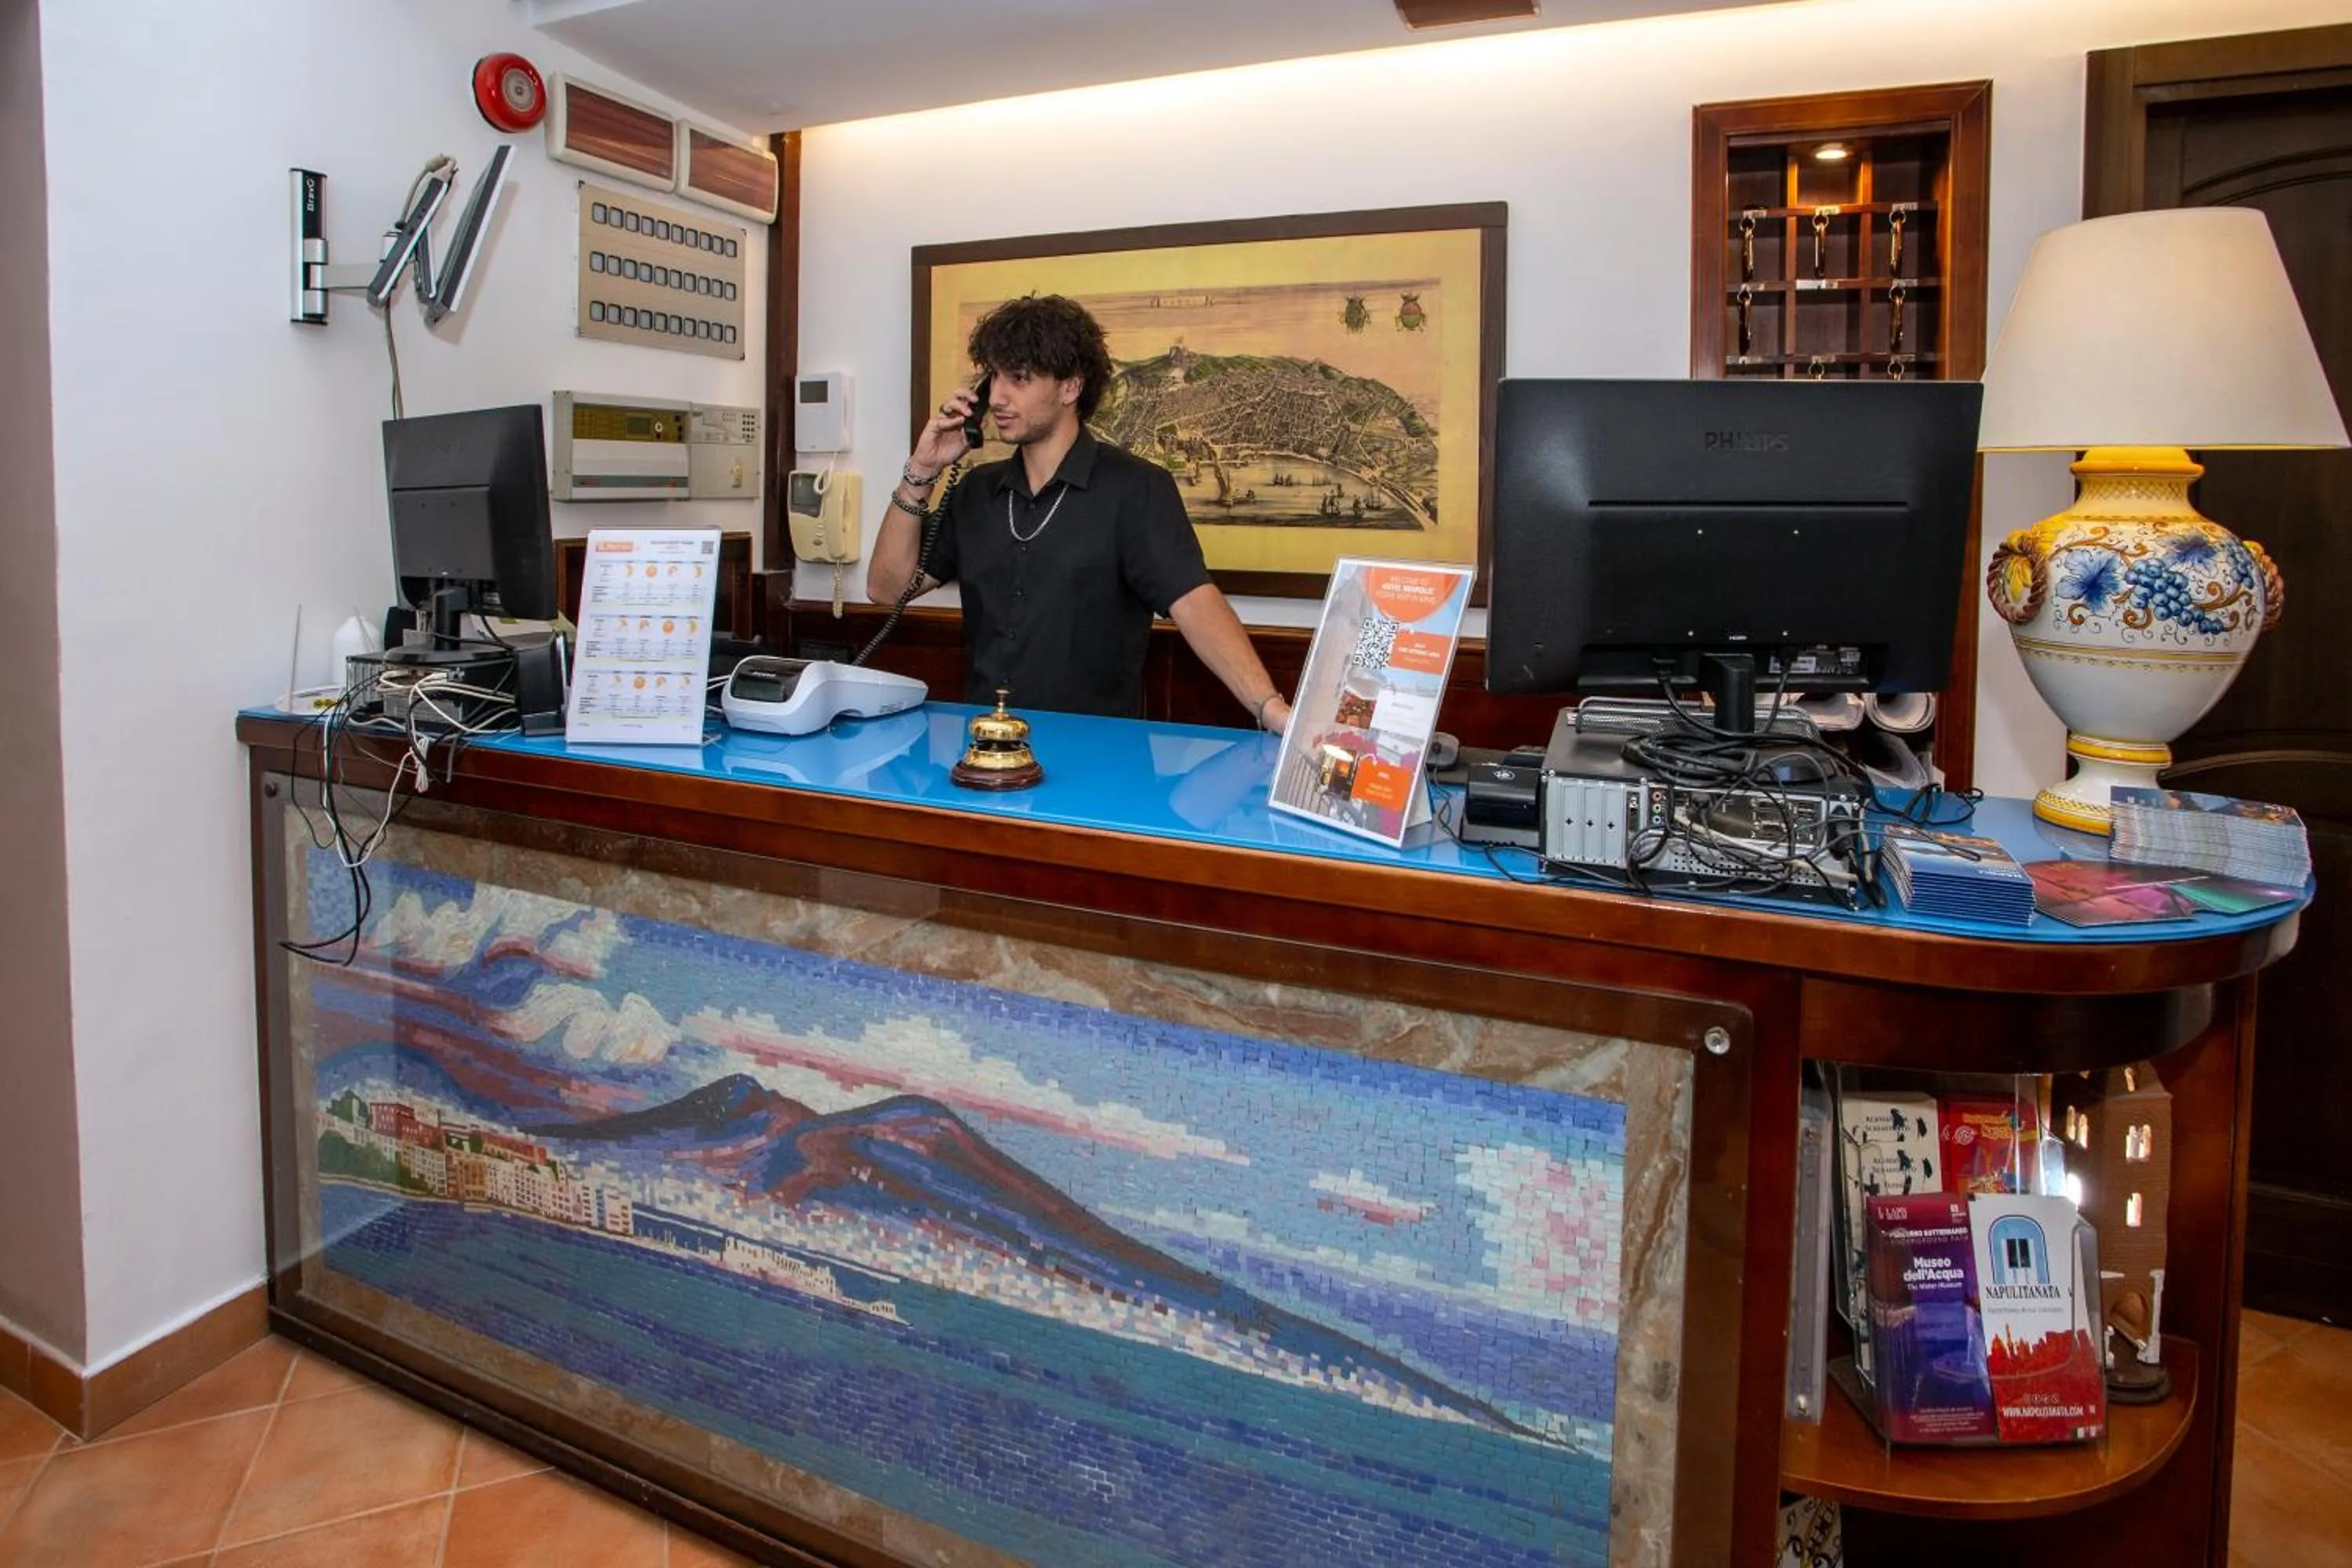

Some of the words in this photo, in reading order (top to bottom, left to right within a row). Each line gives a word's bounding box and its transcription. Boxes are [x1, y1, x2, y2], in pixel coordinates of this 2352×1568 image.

[1913, 1257, 1951, 1269] Museo
[1903, 1268, 1964, 1282] dell'Acqua
[1985, 1285, 2061, 1299] NAPULITANATA
